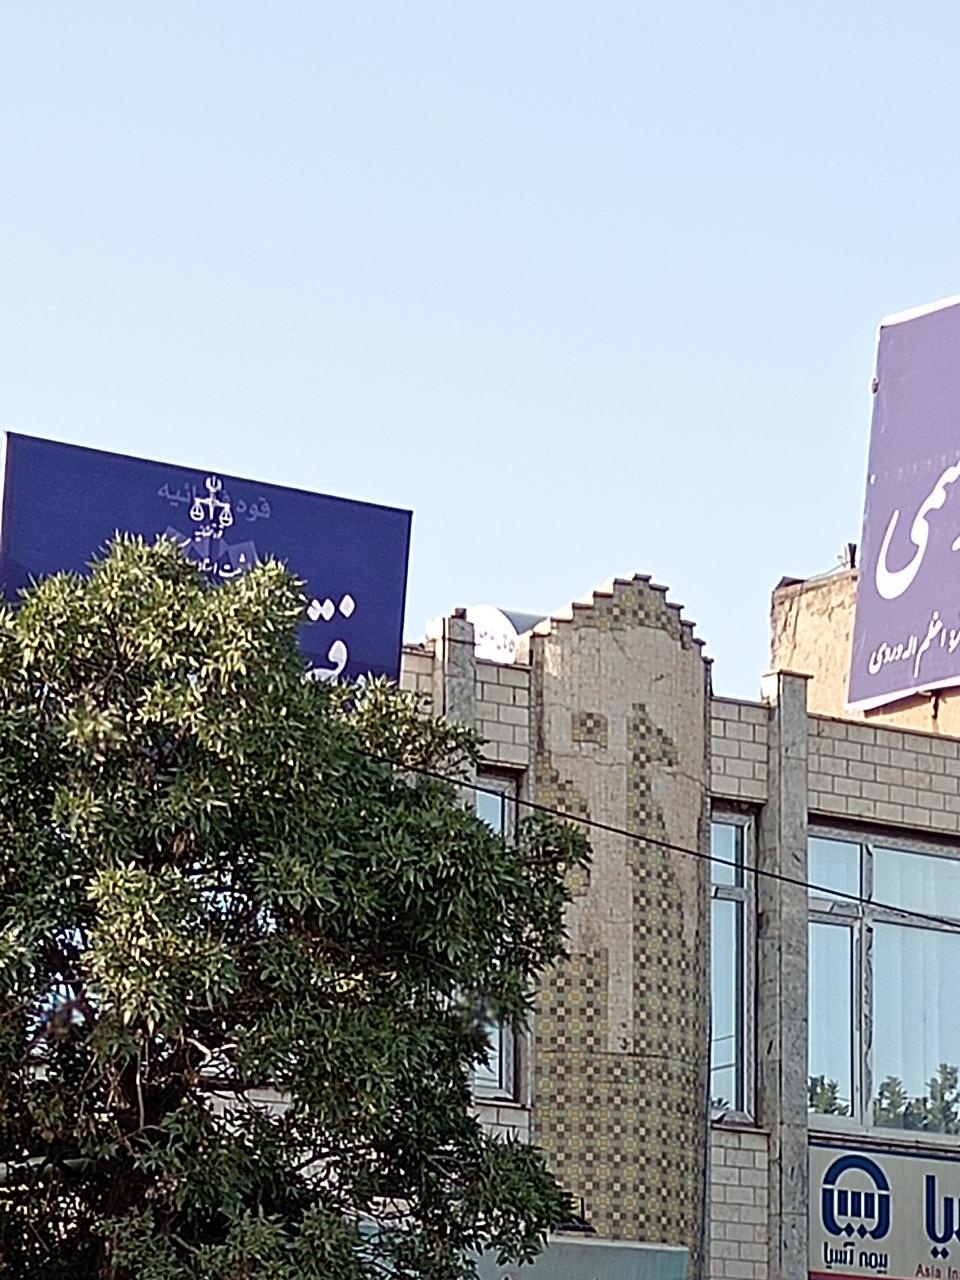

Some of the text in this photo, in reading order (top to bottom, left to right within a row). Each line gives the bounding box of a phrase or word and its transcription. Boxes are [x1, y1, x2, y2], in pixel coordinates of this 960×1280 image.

[823, 1241, 889, 1275] بیمه آسیا
[915, 1263, 942, 1279] Asia
